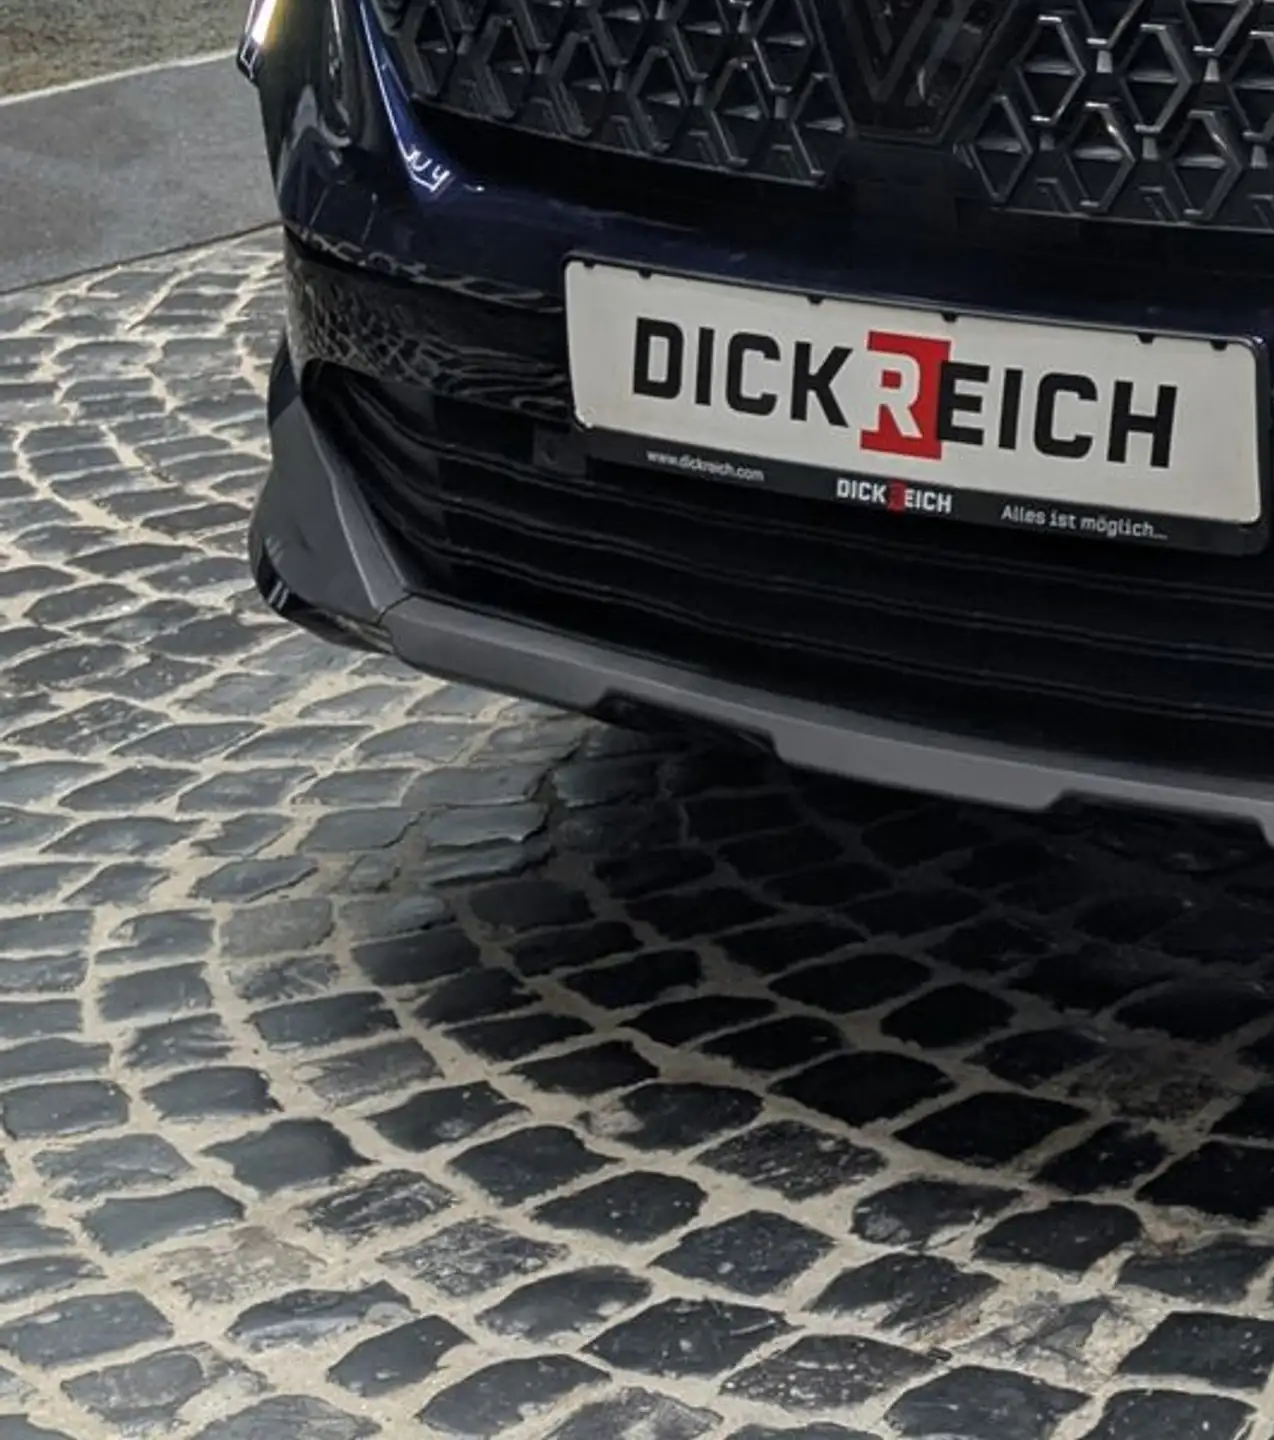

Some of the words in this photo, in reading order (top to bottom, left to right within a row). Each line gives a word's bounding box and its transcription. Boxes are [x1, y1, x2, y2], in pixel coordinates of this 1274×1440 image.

[632, 316, 1178, 468] DICKREICH
[1001, 504, 1046, 525] Alles
[1050, 509, 1077, 530] ist
